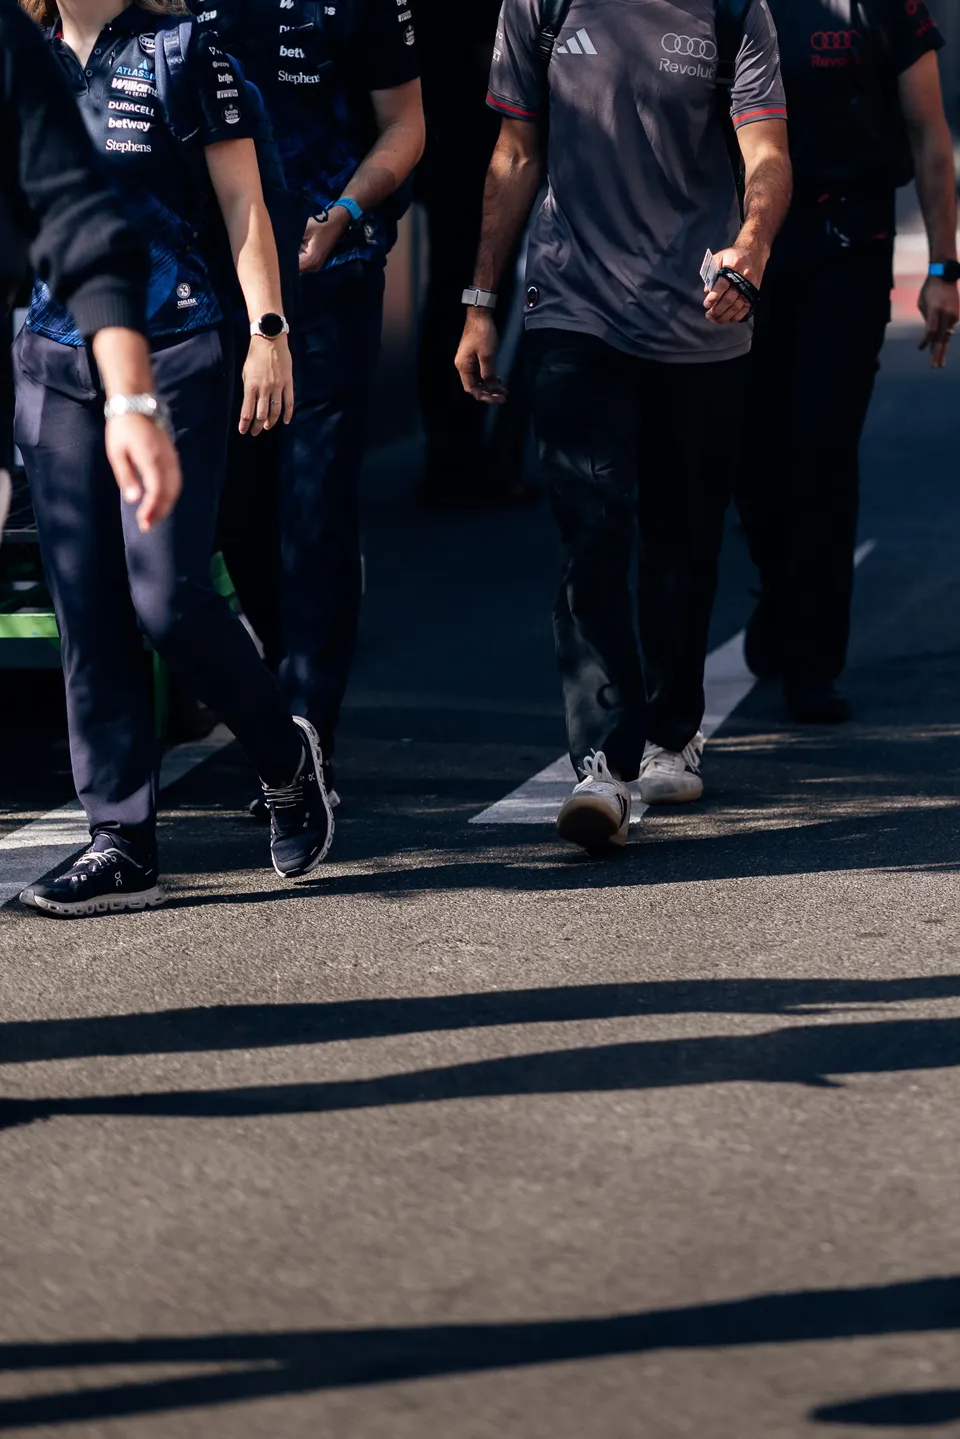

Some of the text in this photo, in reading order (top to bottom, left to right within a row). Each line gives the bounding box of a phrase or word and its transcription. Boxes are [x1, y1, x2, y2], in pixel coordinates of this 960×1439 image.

[116, 66, 156, 80] ATLASSI
[108, 101, 155, 117] DURACELL
[108, 117, 151, 132] betway
[105, 138, 152, 153] Stephens
